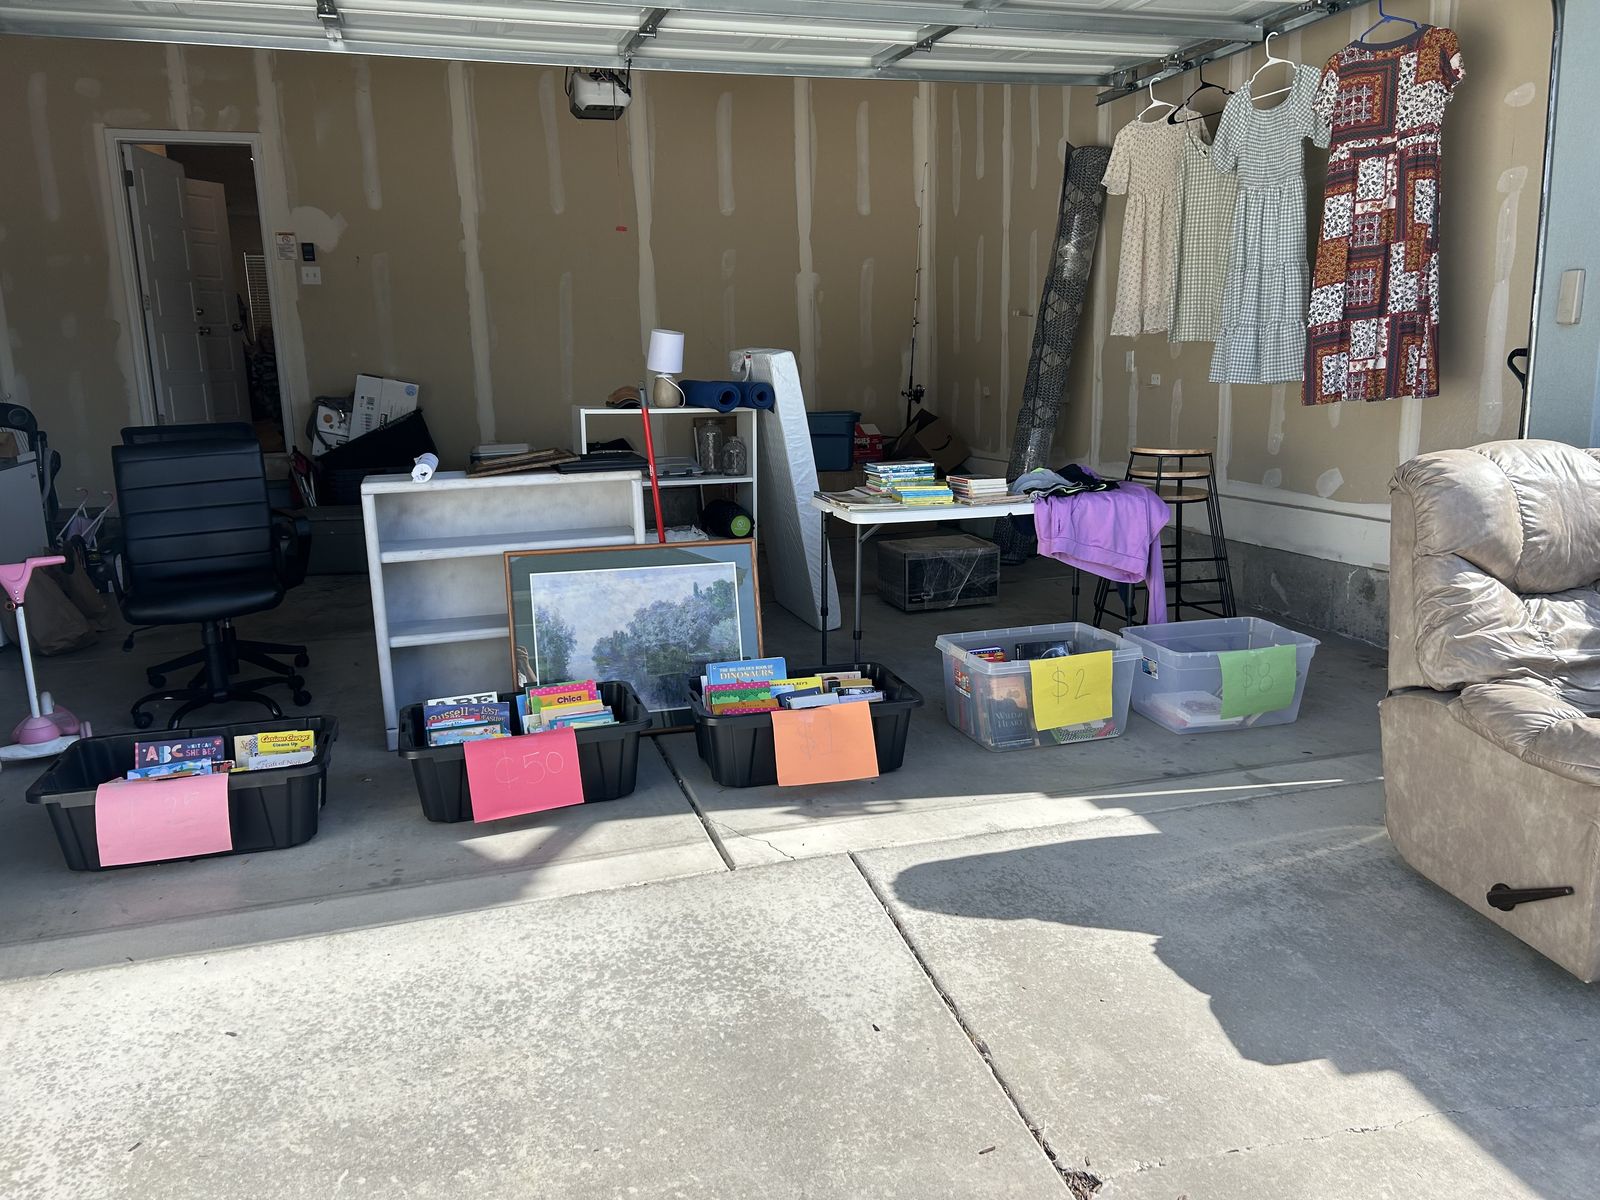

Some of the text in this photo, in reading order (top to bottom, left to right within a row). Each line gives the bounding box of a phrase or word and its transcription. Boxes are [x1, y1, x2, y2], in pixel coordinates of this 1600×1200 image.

[720, 669, 774, 680] DINOSAURS
[1241, 661, 1275, 697] $8
[1051, 666, 1092, 705] $2
[556, 694, 583, 704] Chica
[260, 733, 311, 743] Curious George
[145, 743, 185, 764] ABC
[185, 747, 217, 757] SHE BE?
